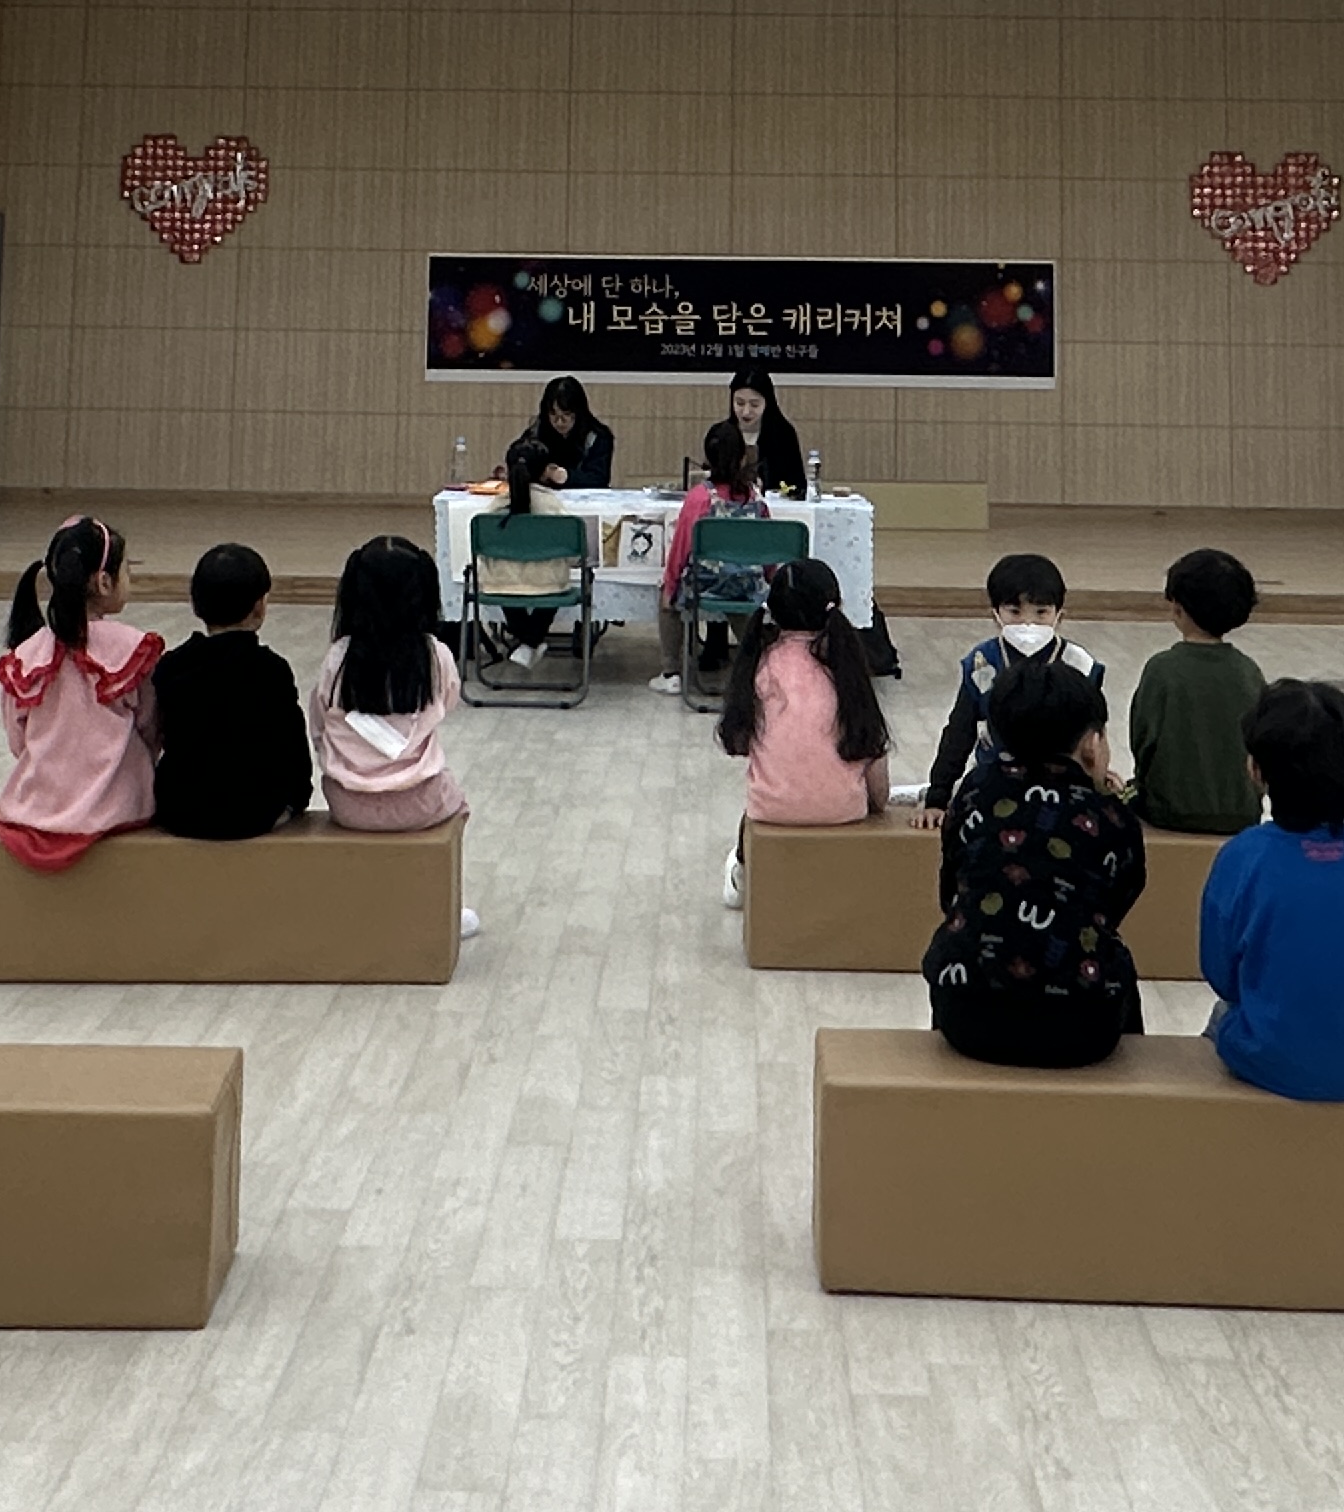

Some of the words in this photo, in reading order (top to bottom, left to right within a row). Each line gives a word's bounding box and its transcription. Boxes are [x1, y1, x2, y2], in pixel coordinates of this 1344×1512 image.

[527, 272, 593, 299] 세상에
[600, 272, 624, 299] 단
[628, 272, 681, 300] 하나,
[567, 299, 596, 335] 내
[606, 300, 702, 336] 모습을
[712, 300, 774, 336] 담은
[781, 301, 903, 338] 캐리커쳐
